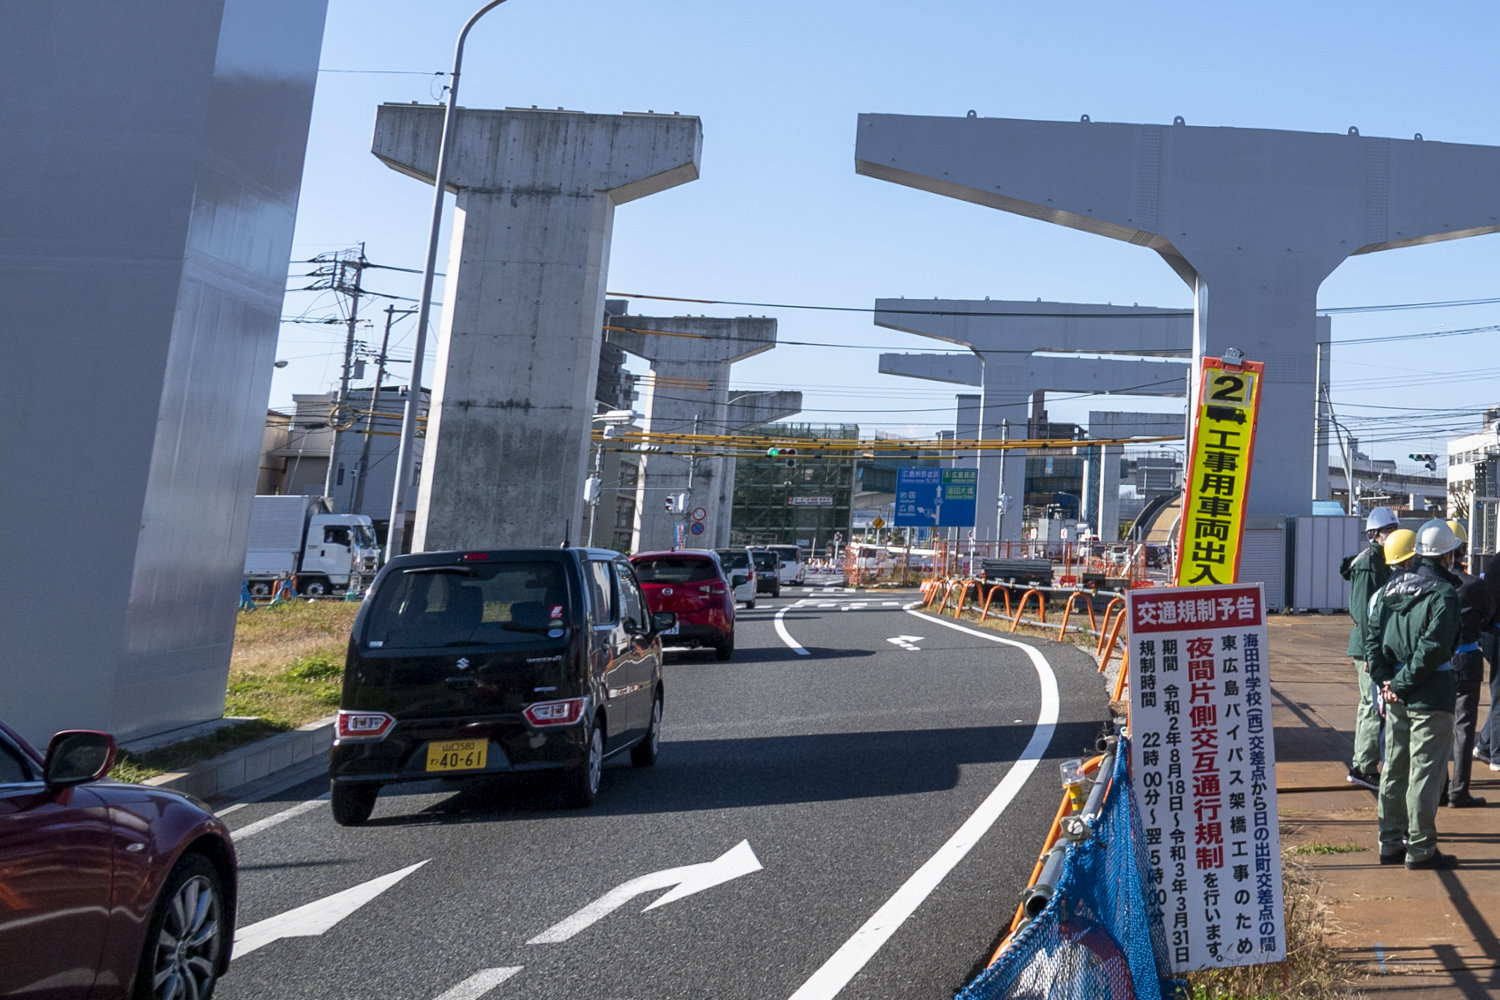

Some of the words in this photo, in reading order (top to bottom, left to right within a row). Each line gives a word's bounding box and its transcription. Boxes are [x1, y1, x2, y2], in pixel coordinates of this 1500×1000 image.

[1211, 376, 1244, 402] 2
[1188, 429, 1241, 585] 工事用車両出入
[1137, 596, 1256, 626] 交通規制予告
[1139, 640, 1157, 709] 規制時間
[1162, 639, 1178, 673] 期間
[440, 751, 482, 768] 40-61
[1186, 637, 1225, 962] 夜間片側交互通行規制を行います。
[1221, 635, 1253, 955] 東広島バイパス架橋工事のため
